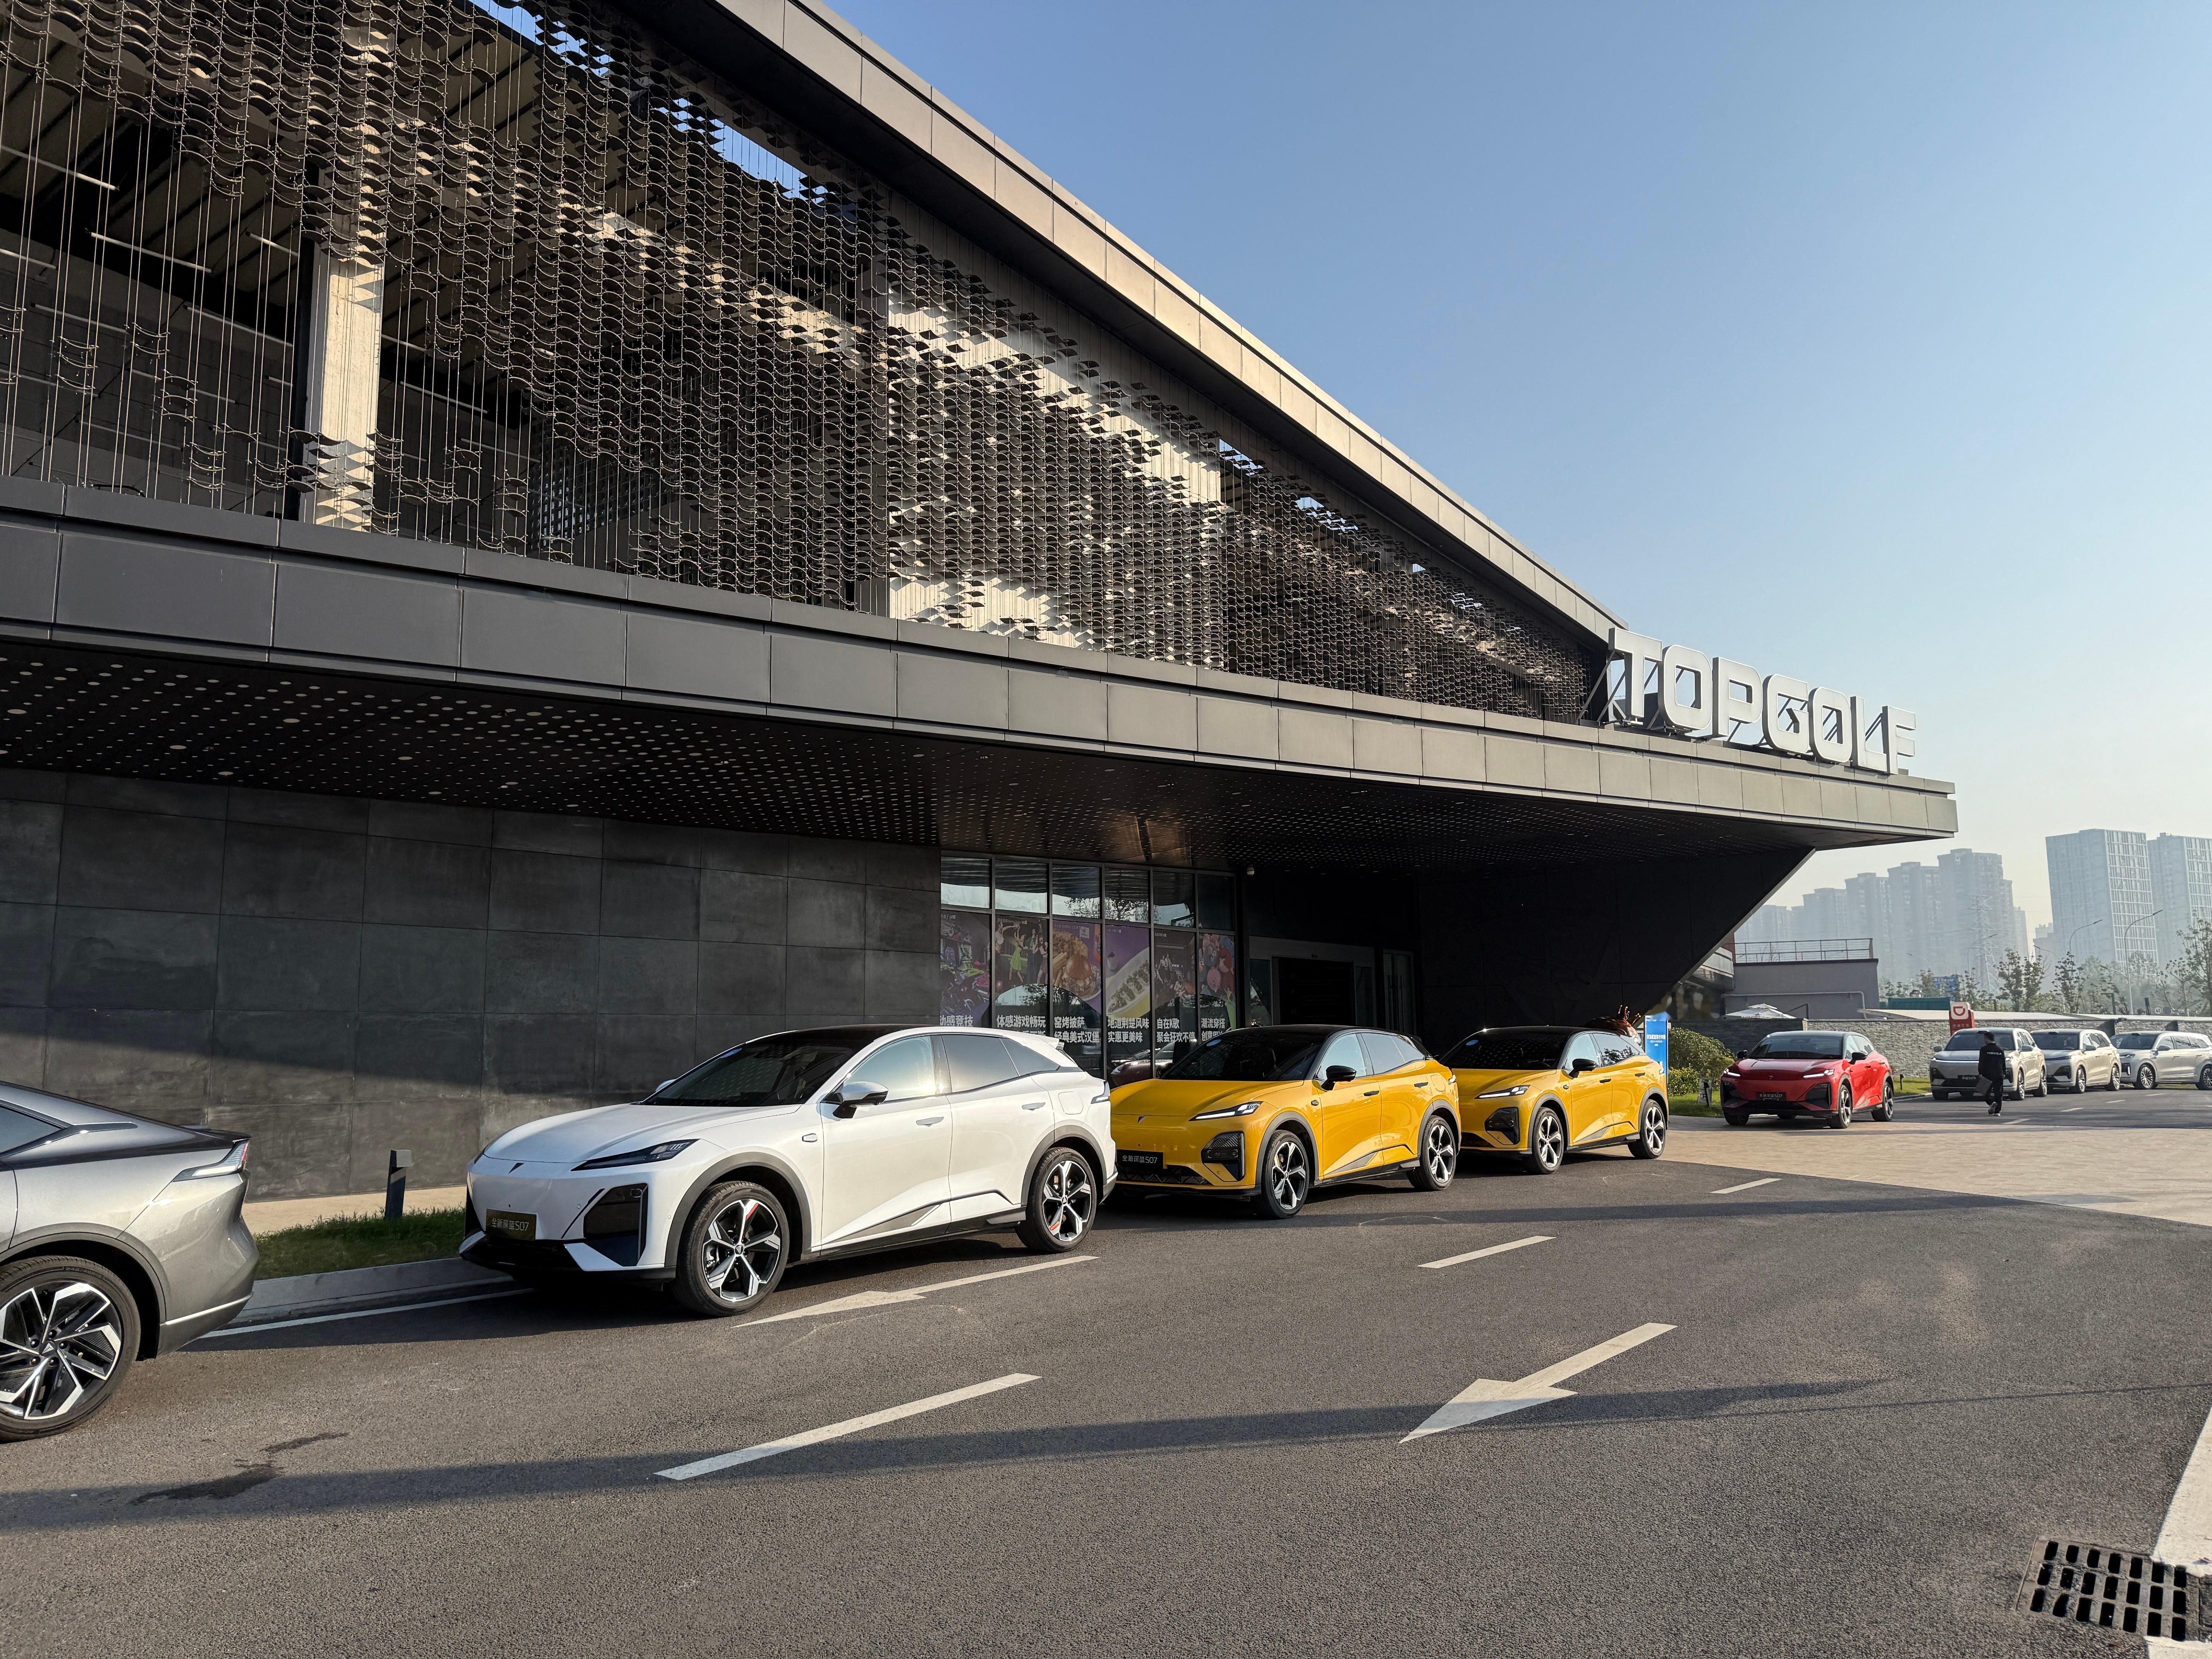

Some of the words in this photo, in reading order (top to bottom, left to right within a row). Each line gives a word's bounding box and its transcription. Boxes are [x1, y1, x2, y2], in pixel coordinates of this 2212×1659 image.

[1609, 627, 1916, 774] TOPGOLF
[996, 1015, 1046, 1028] 体感游戏畅玩
[1054, 1016, 1085, 1029] 窑烤披萨
[1108, 1017, 1149, 1029] 地道荆楚风味
[1157, 1018, 1180, 1029] 自在K歌
[1201, 1017, 1225, 1029] 潮流穿搭
[1054, 1031, 1100, 1043] 经典美式汉堡
[1108, 1031, 1143, 1043] 实惠更美味
[1157, 1031, 1195, 1043] 聚会狂欢不停
